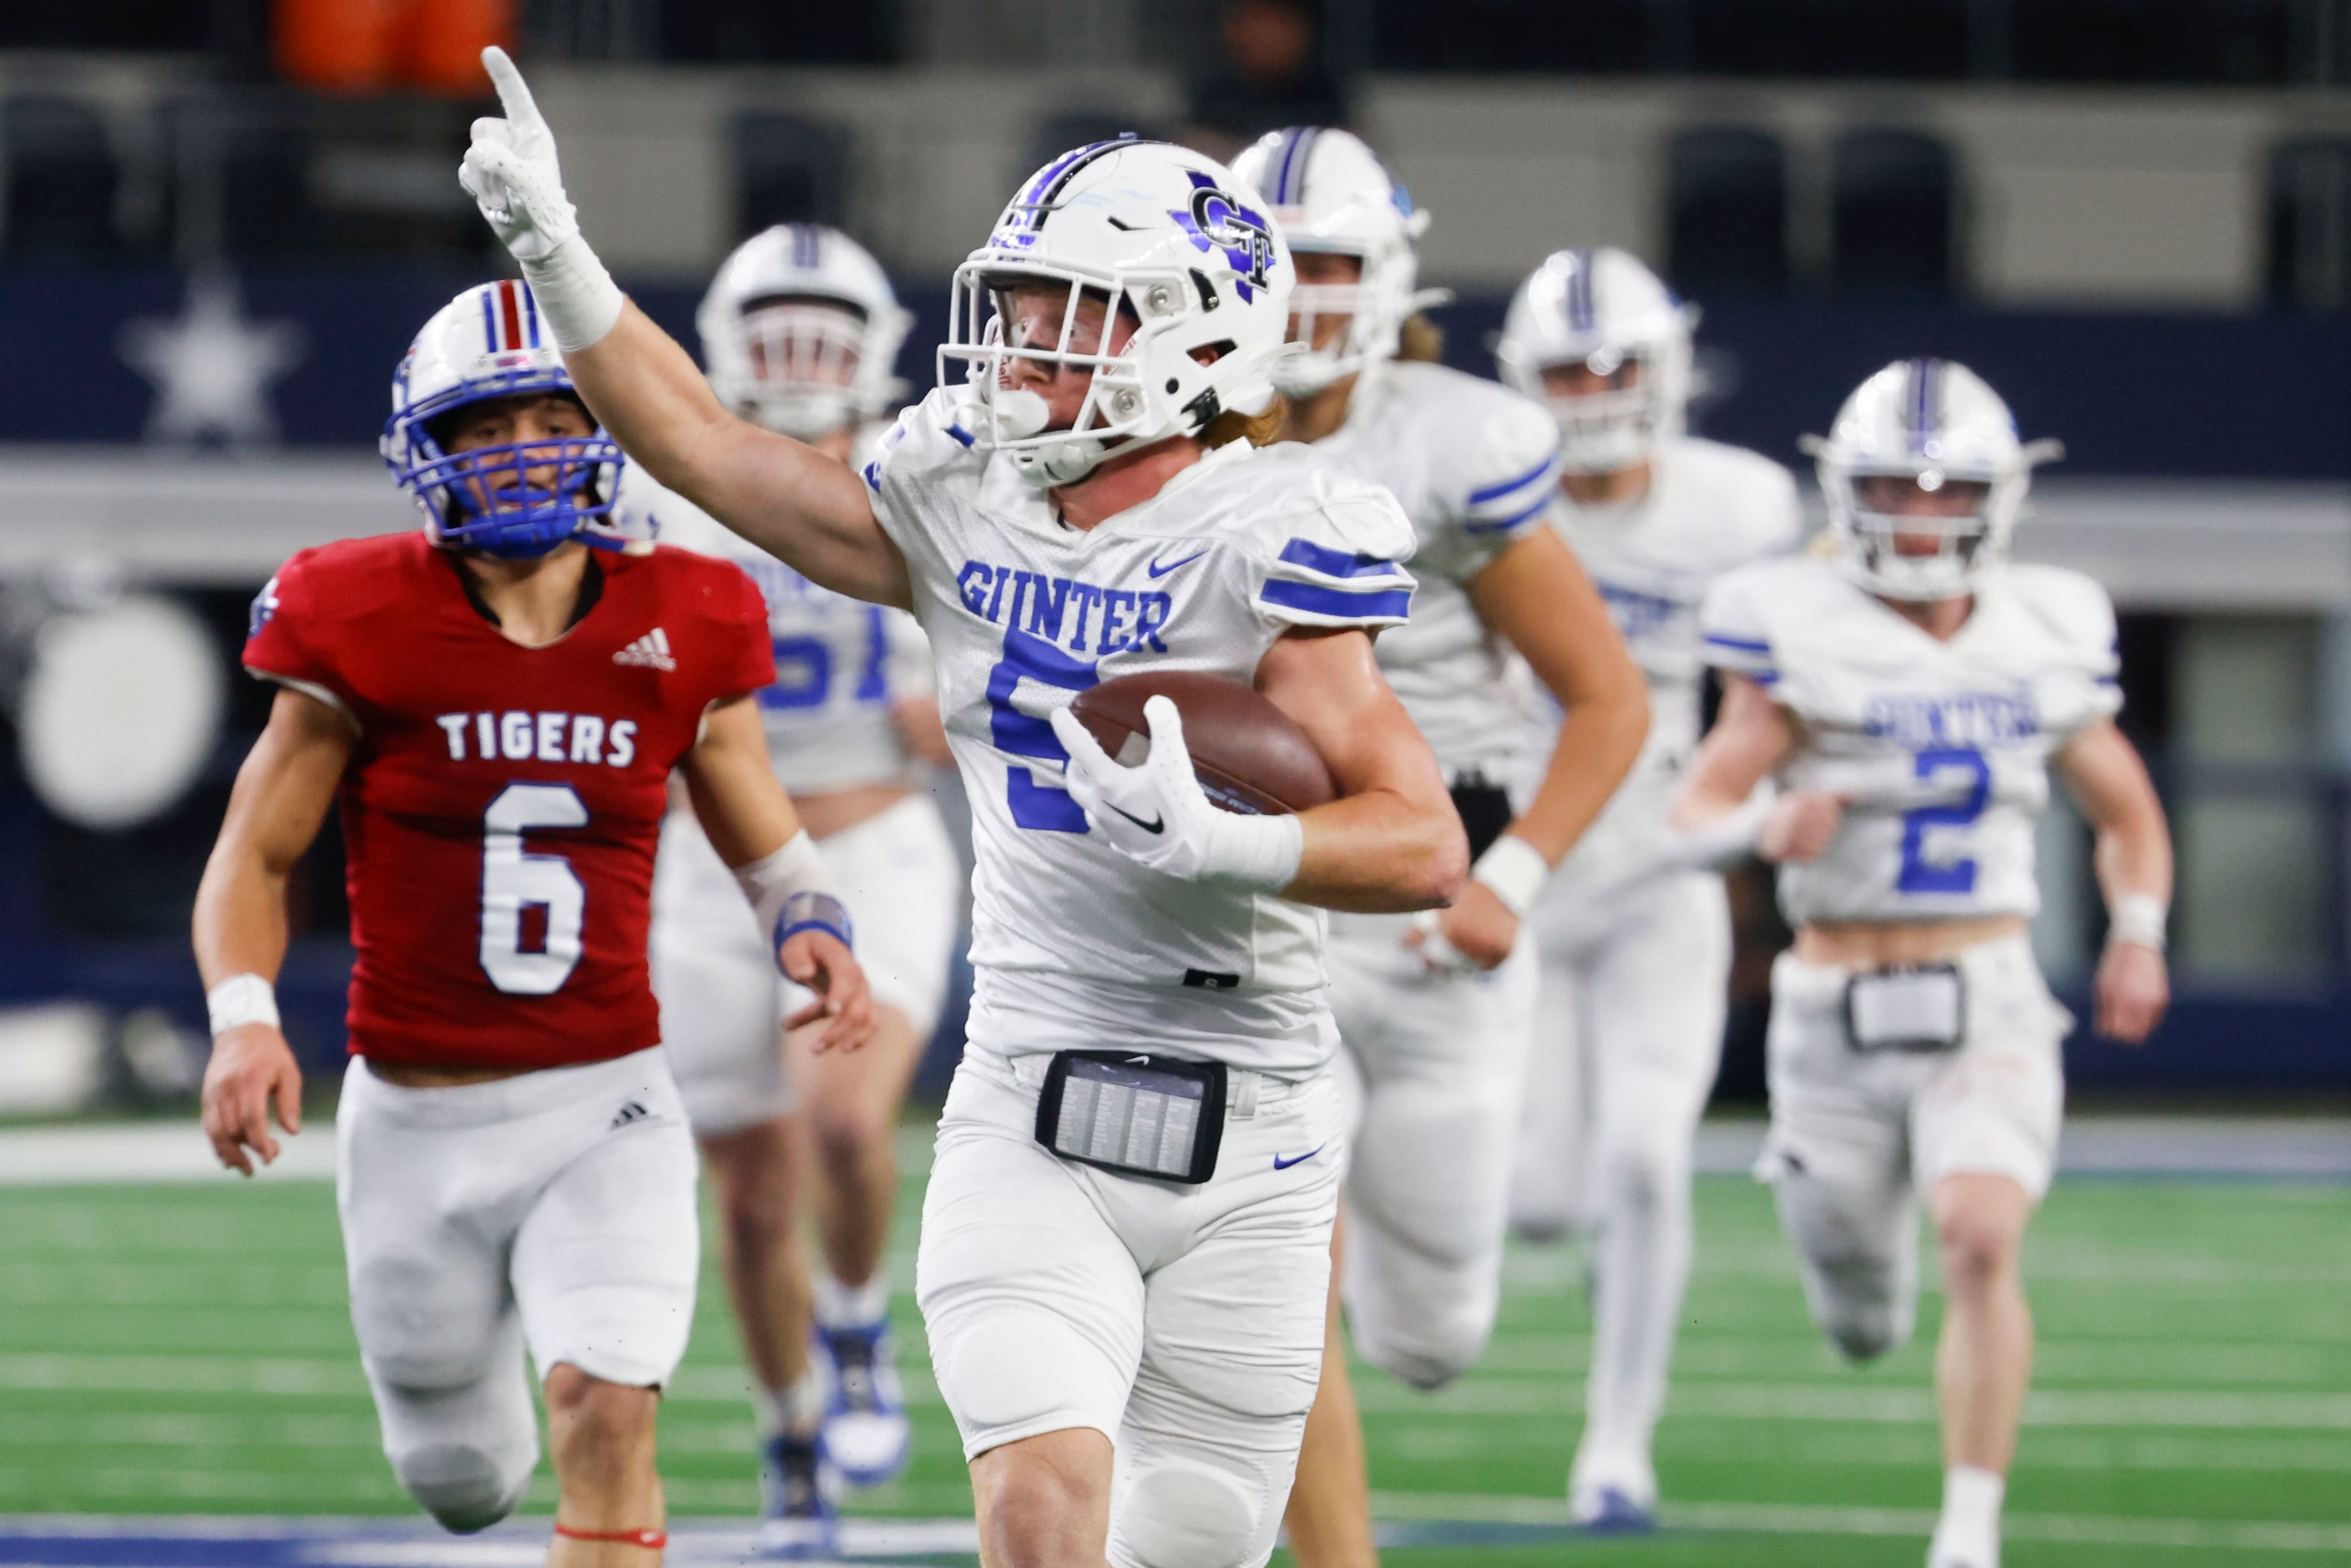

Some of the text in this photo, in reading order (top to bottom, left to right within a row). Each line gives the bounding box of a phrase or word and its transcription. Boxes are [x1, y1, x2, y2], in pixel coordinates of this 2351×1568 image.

[957, 559, 1172, 655] GUNTER
[436, 711, 639, 768] TIGERS
[986, 622, 1101, 834] 5
[479, 778, 589, 996] 6
[1895, 747, 1990, 893] 2
